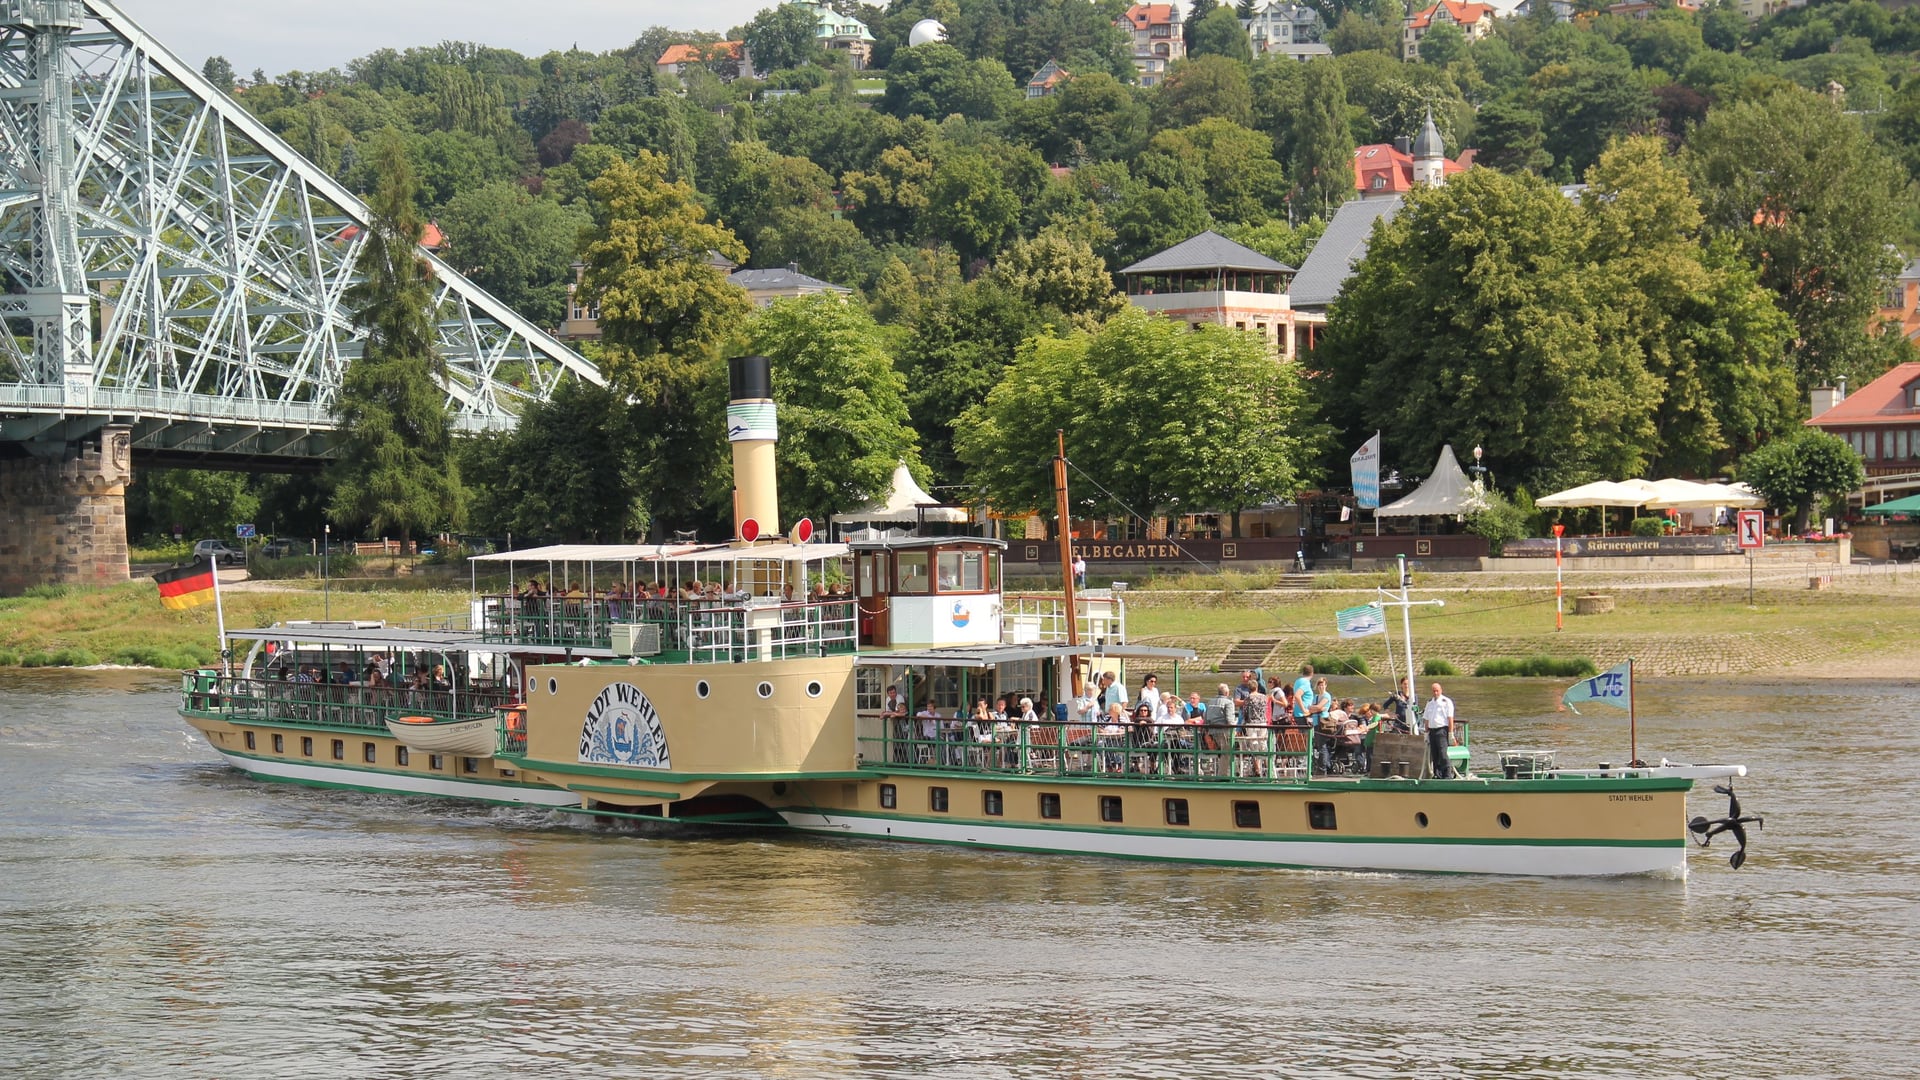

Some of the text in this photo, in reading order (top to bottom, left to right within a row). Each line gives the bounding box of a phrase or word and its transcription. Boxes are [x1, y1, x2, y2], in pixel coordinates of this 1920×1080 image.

[1071, 545, 1180, 558] ELBEGARTEN
[1587, 540, 1659, 552] Körnergarten
[1587, 673, 1623, 697] 175
[580, 683, 669, 765] STADT WEHLEN
[1608, 794, 1654, 802] STADT WEHLEN
